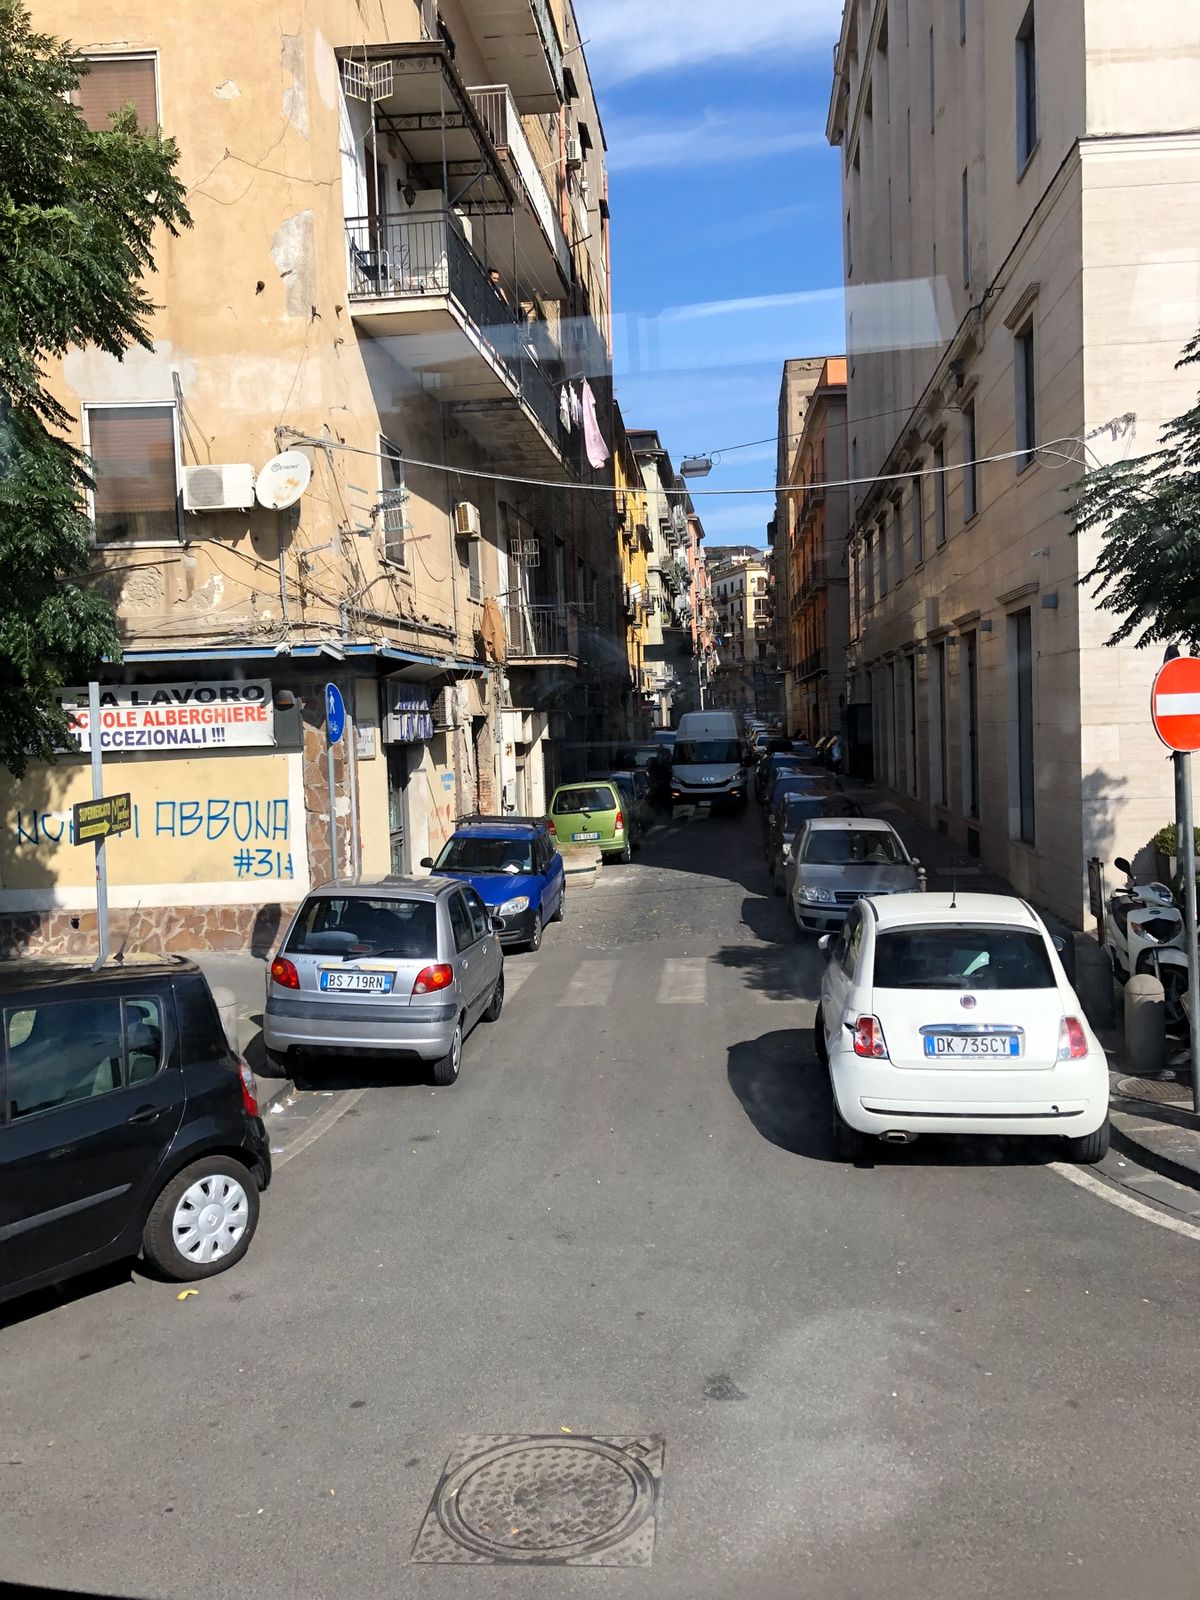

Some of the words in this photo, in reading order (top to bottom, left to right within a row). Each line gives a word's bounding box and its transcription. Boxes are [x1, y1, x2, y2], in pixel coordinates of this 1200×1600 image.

[131, 686, 265, 706] LAVORO
[143, 706, 268, 727] ALBERGHIERE
[89, 728, 207, 748] CCEZIONALI
[155, 799, 289, 842] ABBONA
[328, 974, 344, 988] BS
[346, 975, 385, 990] 719RN
[936, 1037, 955, 1053] DK
[960, 1037, 1008, 1053] 735CY
